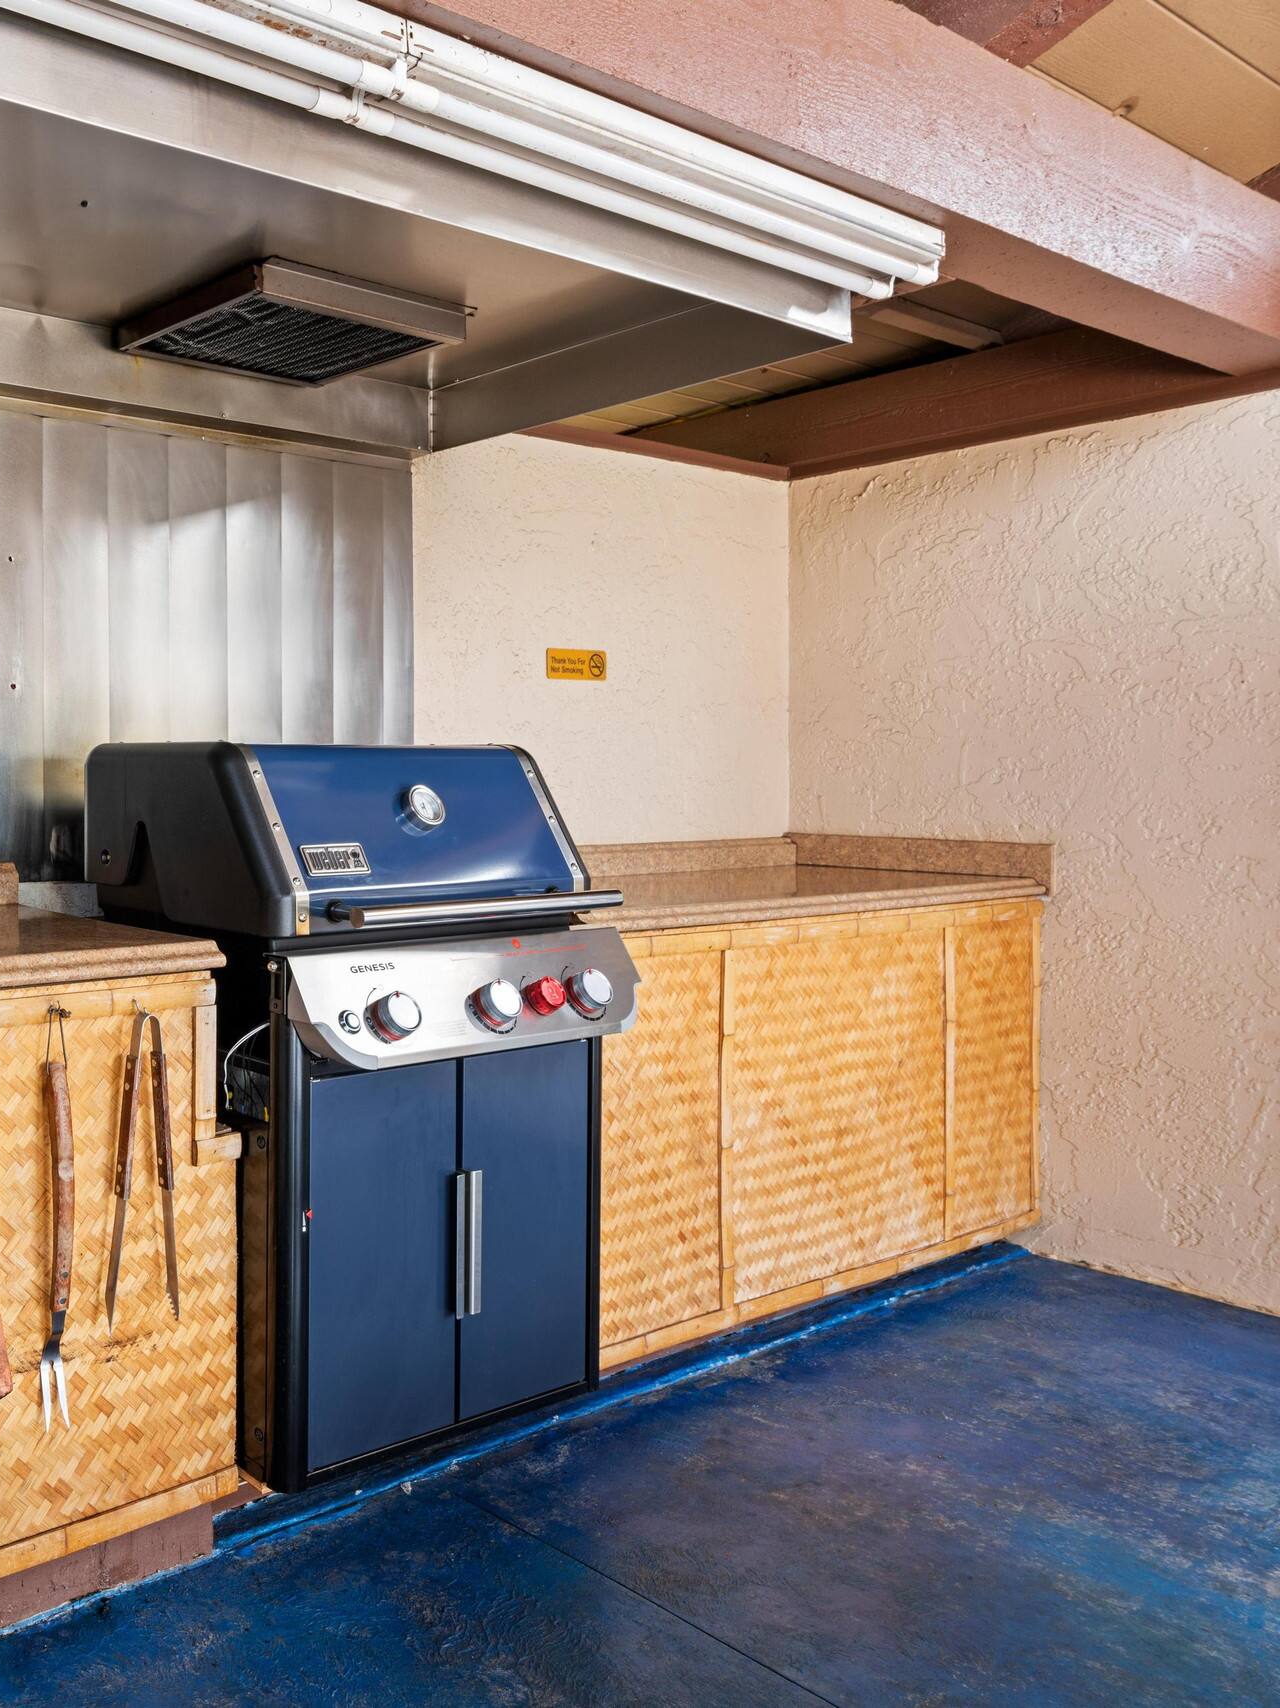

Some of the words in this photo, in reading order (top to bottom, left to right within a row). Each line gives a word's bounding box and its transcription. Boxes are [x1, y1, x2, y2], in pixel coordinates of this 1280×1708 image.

[551, 656, 566, 664] Thank
[567, 656, 576, 665] You
[577, 657, 586, 665] For
[551, 665, 560, 673] Not
[561, 665, 584, 675] Smoking
[307, 846, 351, 870] weber
[350, 962, 395, 974] GENESIS
